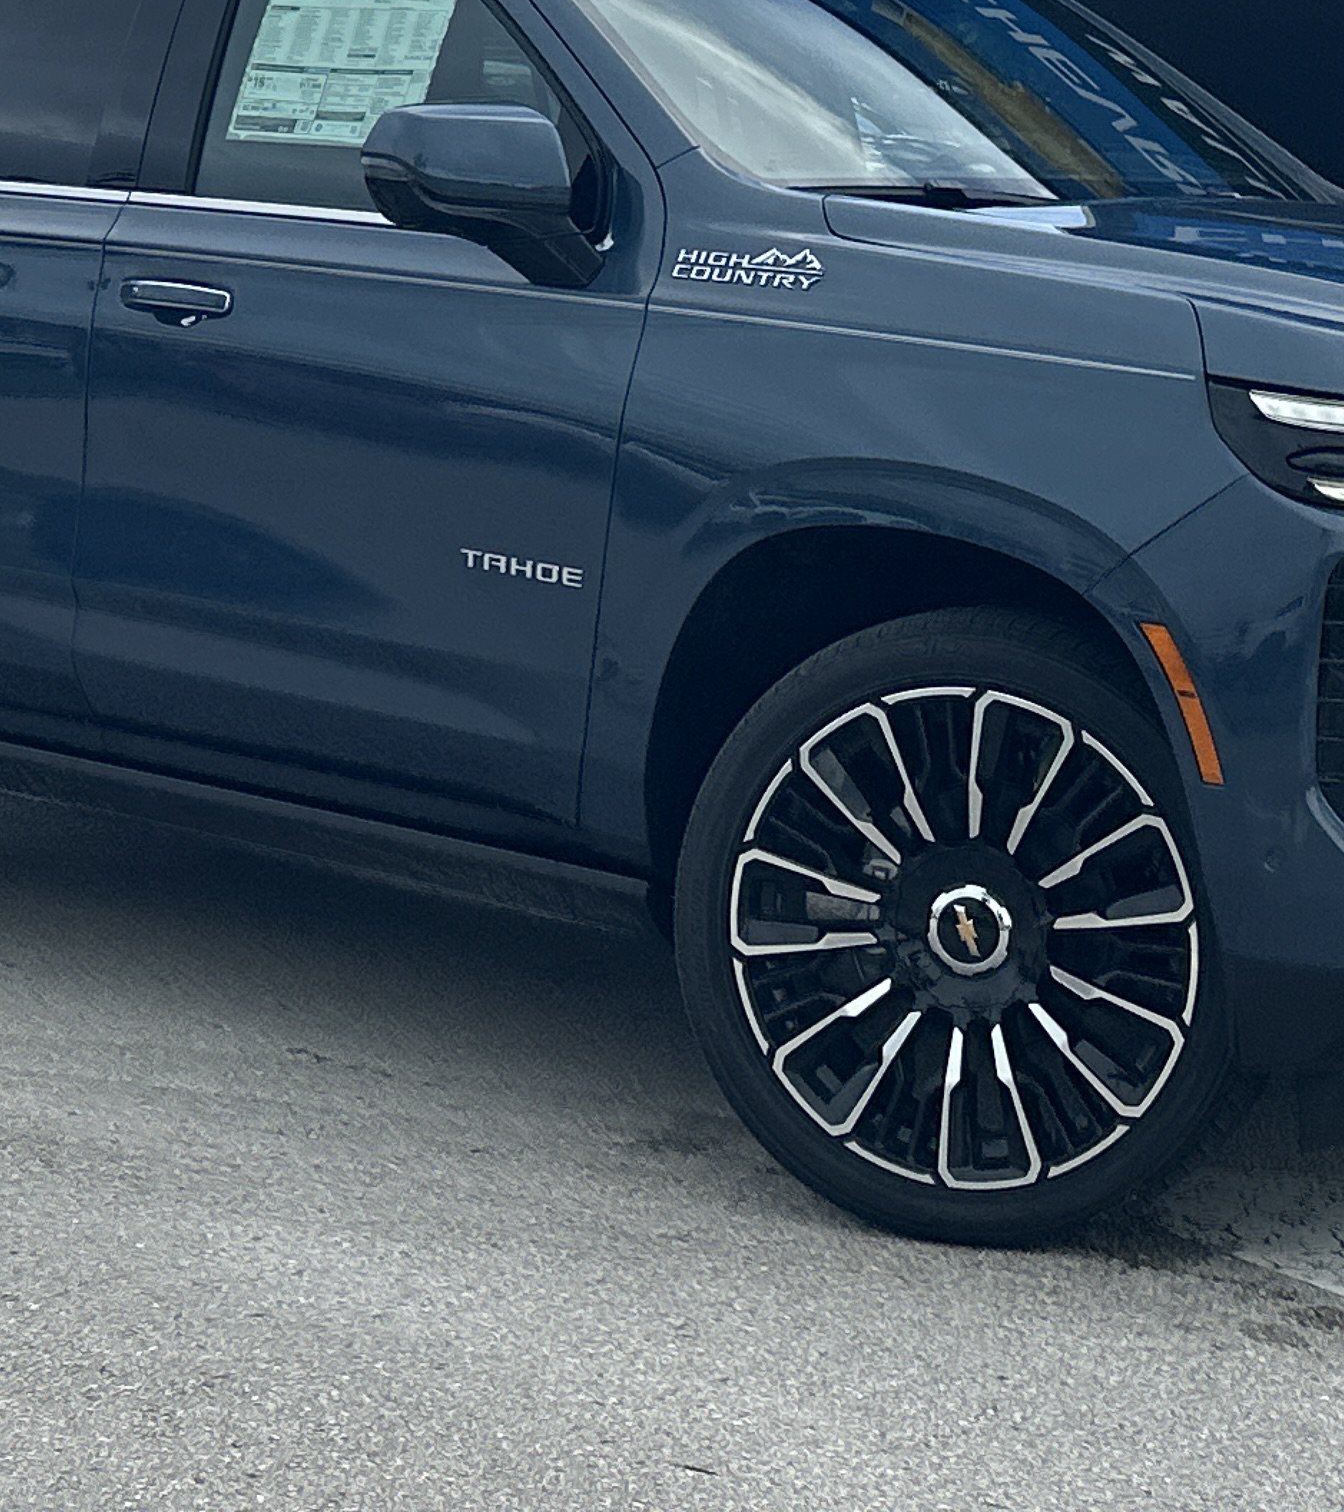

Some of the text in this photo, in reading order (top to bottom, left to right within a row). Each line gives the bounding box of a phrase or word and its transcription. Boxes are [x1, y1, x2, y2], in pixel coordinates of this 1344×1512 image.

[676, 248, 750, 268] HIGH
[671, 263, 823, 290] COUNTRY
[459, 547, 584, 589] TAHOE
